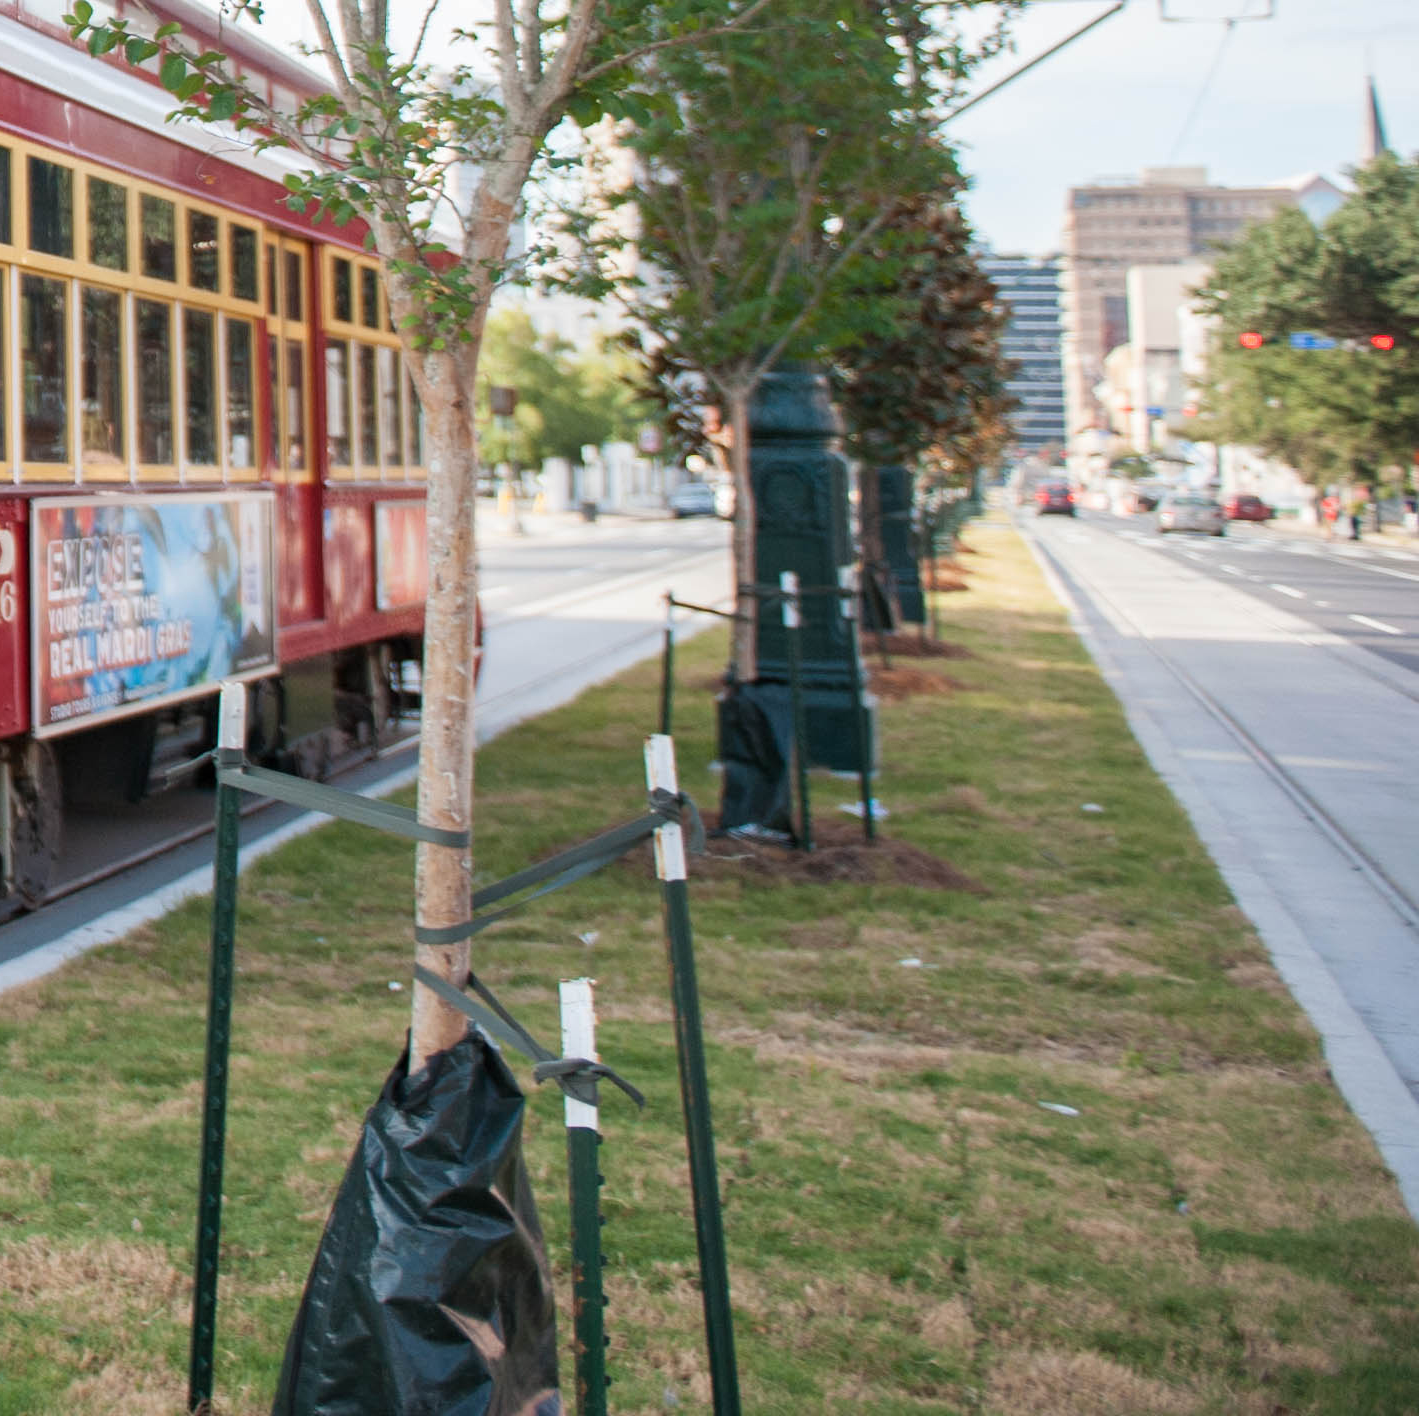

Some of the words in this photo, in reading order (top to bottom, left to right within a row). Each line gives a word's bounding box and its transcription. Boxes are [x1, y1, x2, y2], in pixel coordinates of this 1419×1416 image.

[47, 534, 144, 602] EXPOSE
[48, 601, 106, 634] YOURSELF
[113, 598, 131, 624] TO
[134, 594, 159, 620] THE
[50, 636, 94, 678] REAL
[97, 625, 152, 667] MARDI
[156, 619, 192, 659] GRAS
